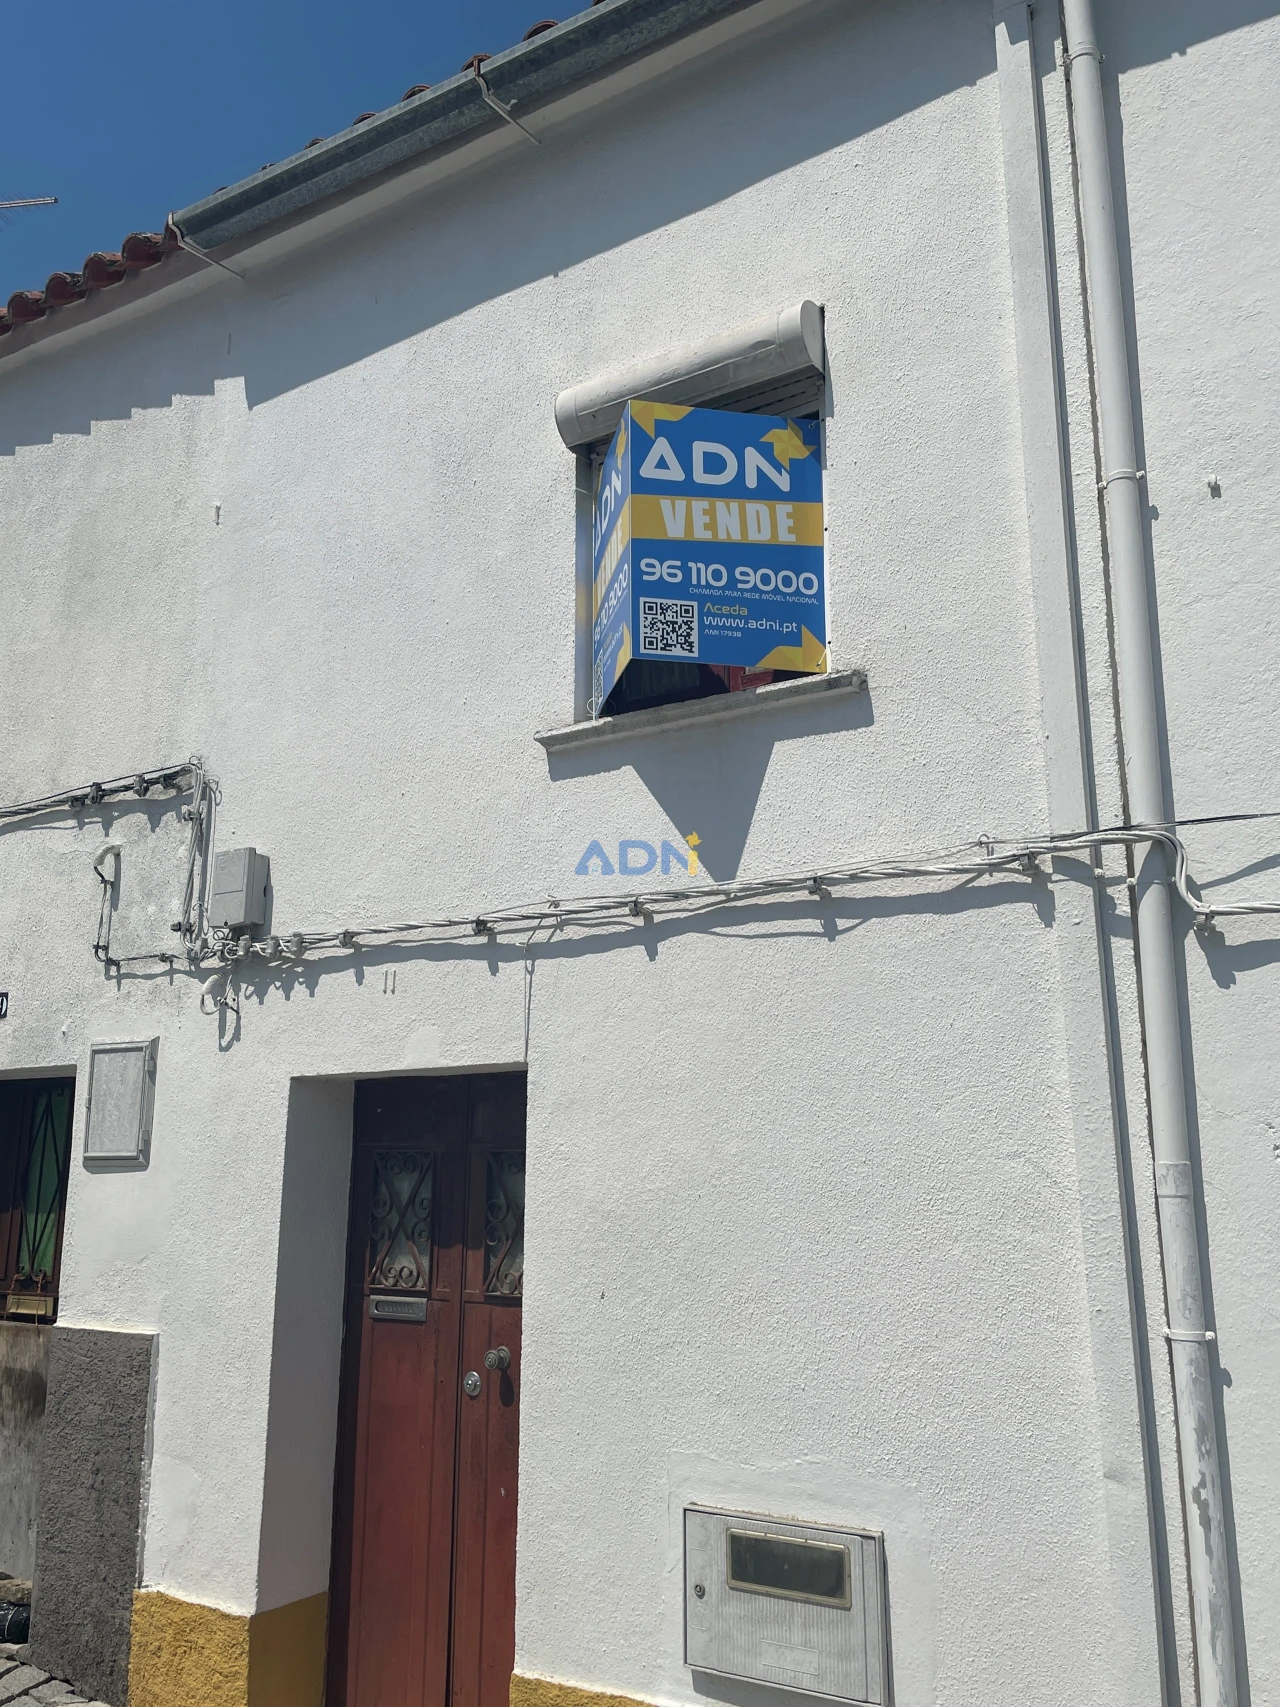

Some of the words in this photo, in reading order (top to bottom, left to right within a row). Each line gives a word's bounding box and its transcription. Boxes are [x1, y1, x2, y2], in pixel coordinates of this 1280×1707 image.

[660, 499, 797, 542] VENDE
[640, 558, 683, 583] 96
[687, 561, 728, 587] 110
[734, 566, 819, 595] 9000
[689, 587, 723, 597] CHAMADA
[724, 590, 742, 598] PARA
[743, 591, 760, 600] REDE
[761, 592, 785, 602] MÓVEL
[786, 595, 820, 605] NACIONAL
[704, 602, 748, 616] Aceda
[703, 616, 798, 634] www.adni.pt
